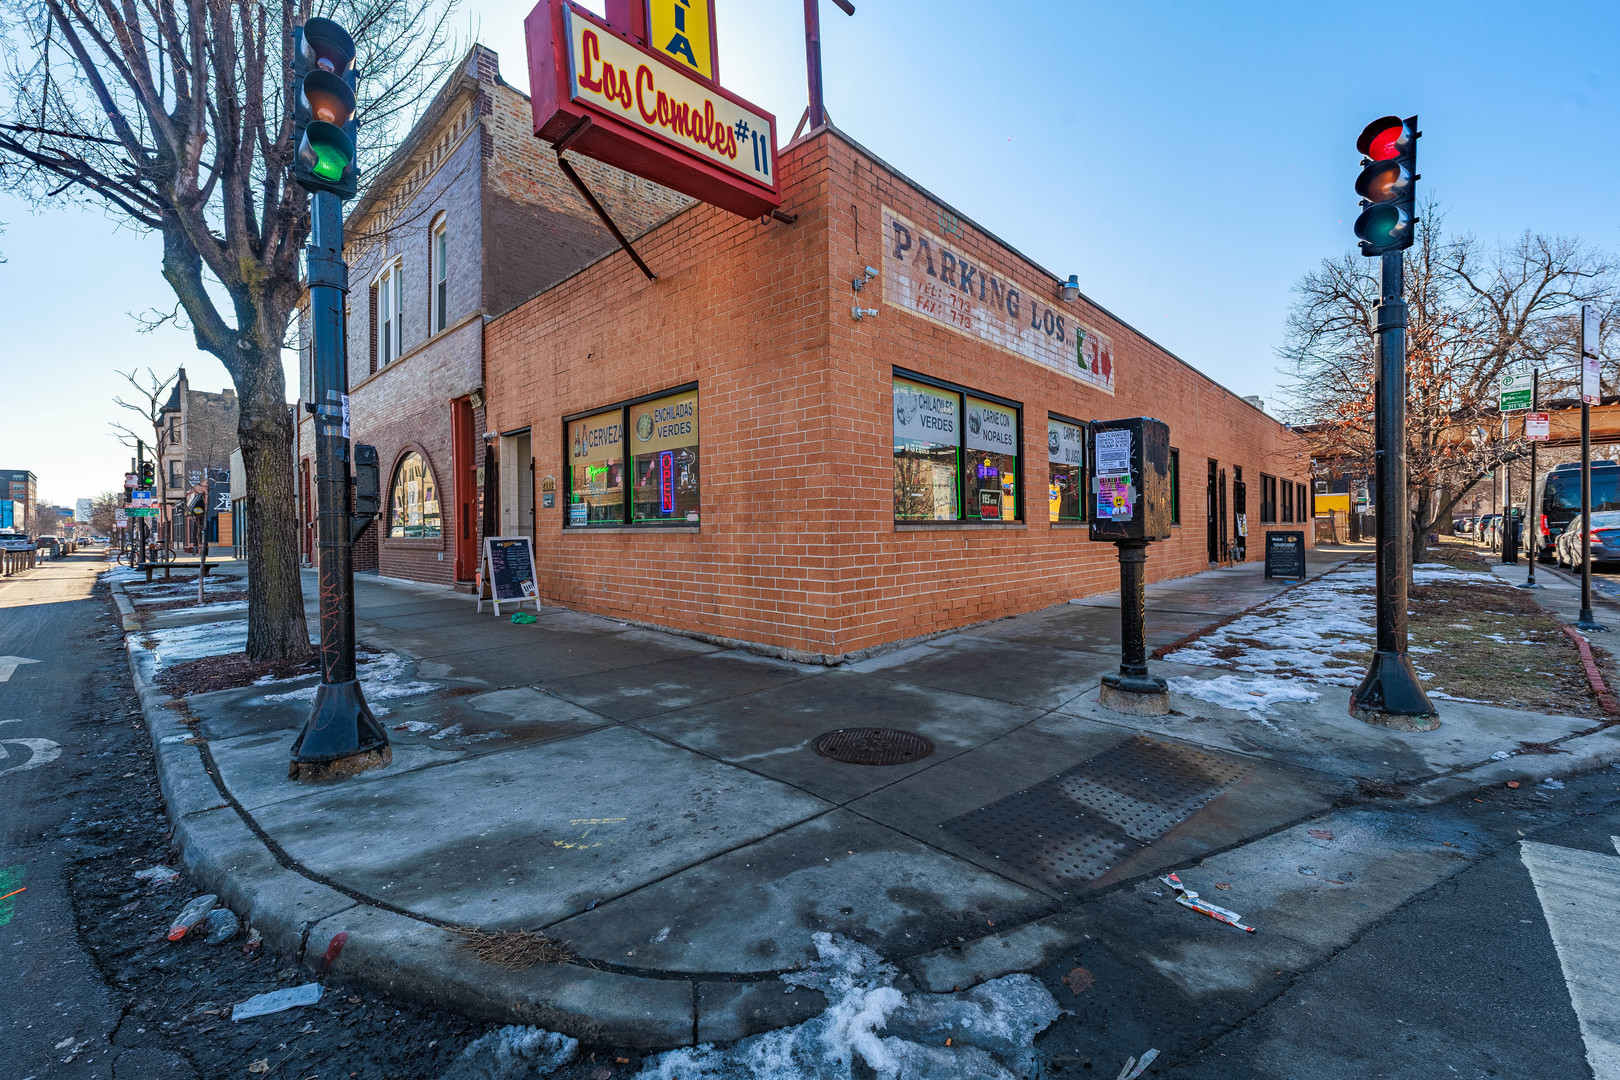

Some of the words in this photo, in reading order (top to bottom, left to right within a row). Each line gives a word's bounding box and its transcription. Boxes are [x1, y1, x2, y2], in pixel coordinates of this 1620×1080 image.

[665, 0, 699, 69] IA
[578, 28, 633, 111] Los
[635, 64, 738, 161] Comales
[892, 221, 1020, 320] PARKING
[654, 401, 693, 423] ENCHILADAS
[656, 420, 692, 439] VERDES
[920, 414, 954, 433] VERDES
[588, 423, 623, 449] CERVEZA
[982, 429, 1013, 446] NOPALES
[661, 454, 672, 511] OPEN
[981, 493, 991, 504] YES
[981, 505, 999, 517] OPEN
